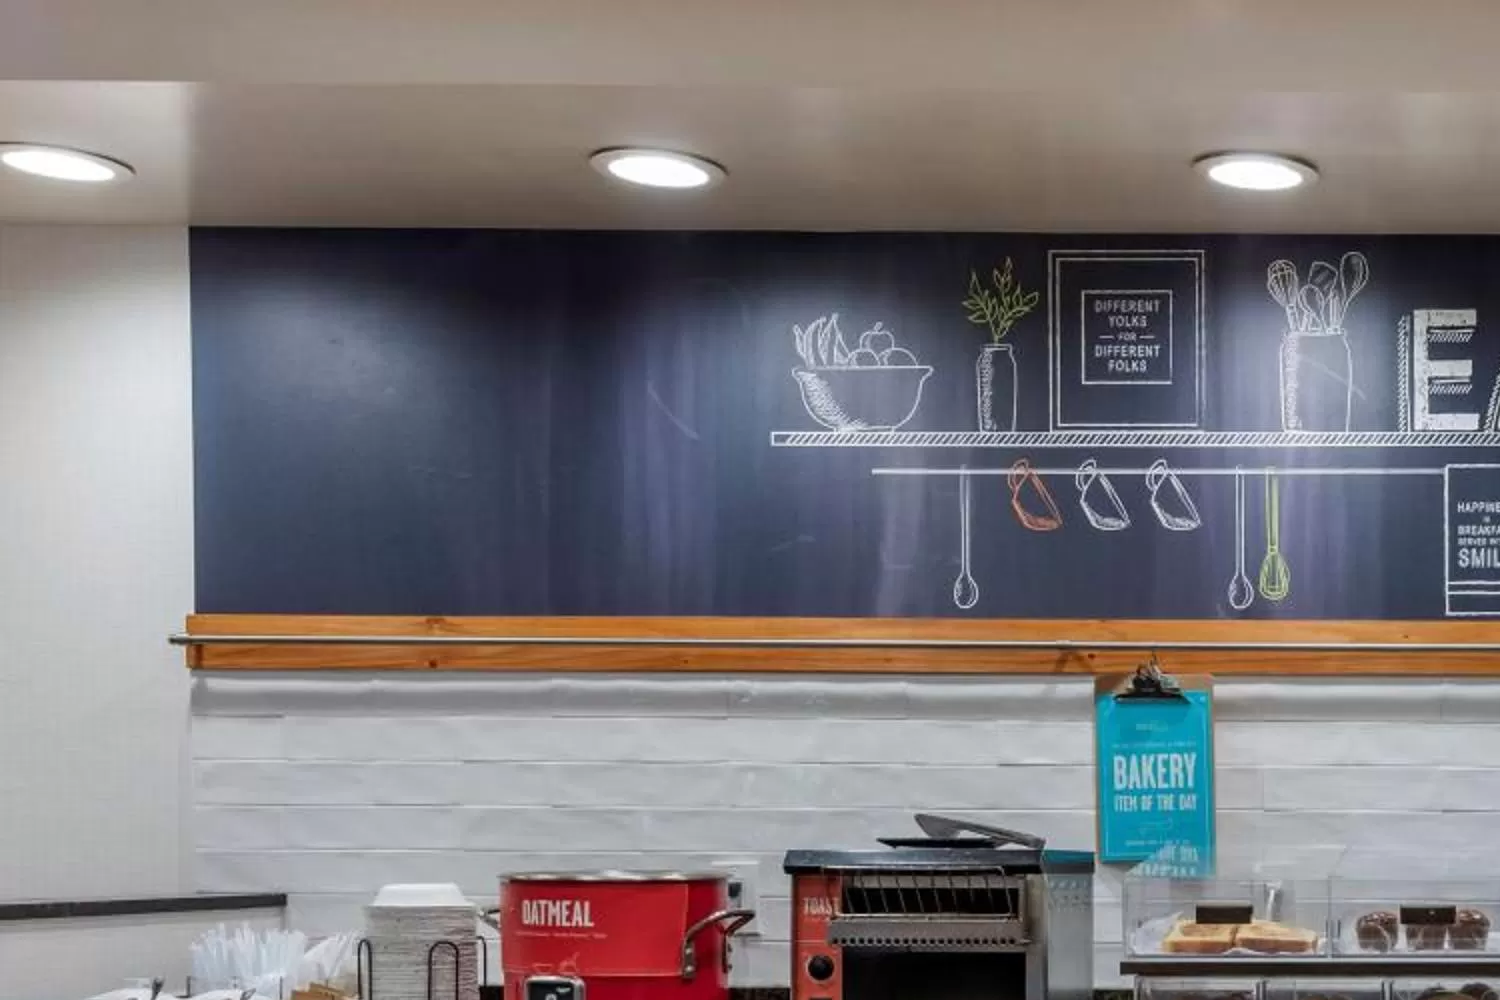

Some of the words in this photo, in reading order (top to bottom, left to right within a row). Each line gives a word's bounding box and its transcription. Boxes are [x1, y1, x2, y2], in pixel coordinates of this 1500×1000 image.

[1095, 299, 1160, 313] DIFFERENT
[1108, 315, 1147, 328] YOLKS
[1119, 331, 1137, 341] FOR
[1095, 344, 1160, 357] DIFFERENT
[1108, 359, 1147, 373] FOLKS
[1113, 752, 1197, 791] BAKERY
[1114, 795, 1138, 813] ITEM
[1141, 794, 1154, 813] OF
[1157, 794, 1175, 811] THE
[1179, 793, 1197, 811] DAY
[522, 899, 595, 928] OATMEAL
